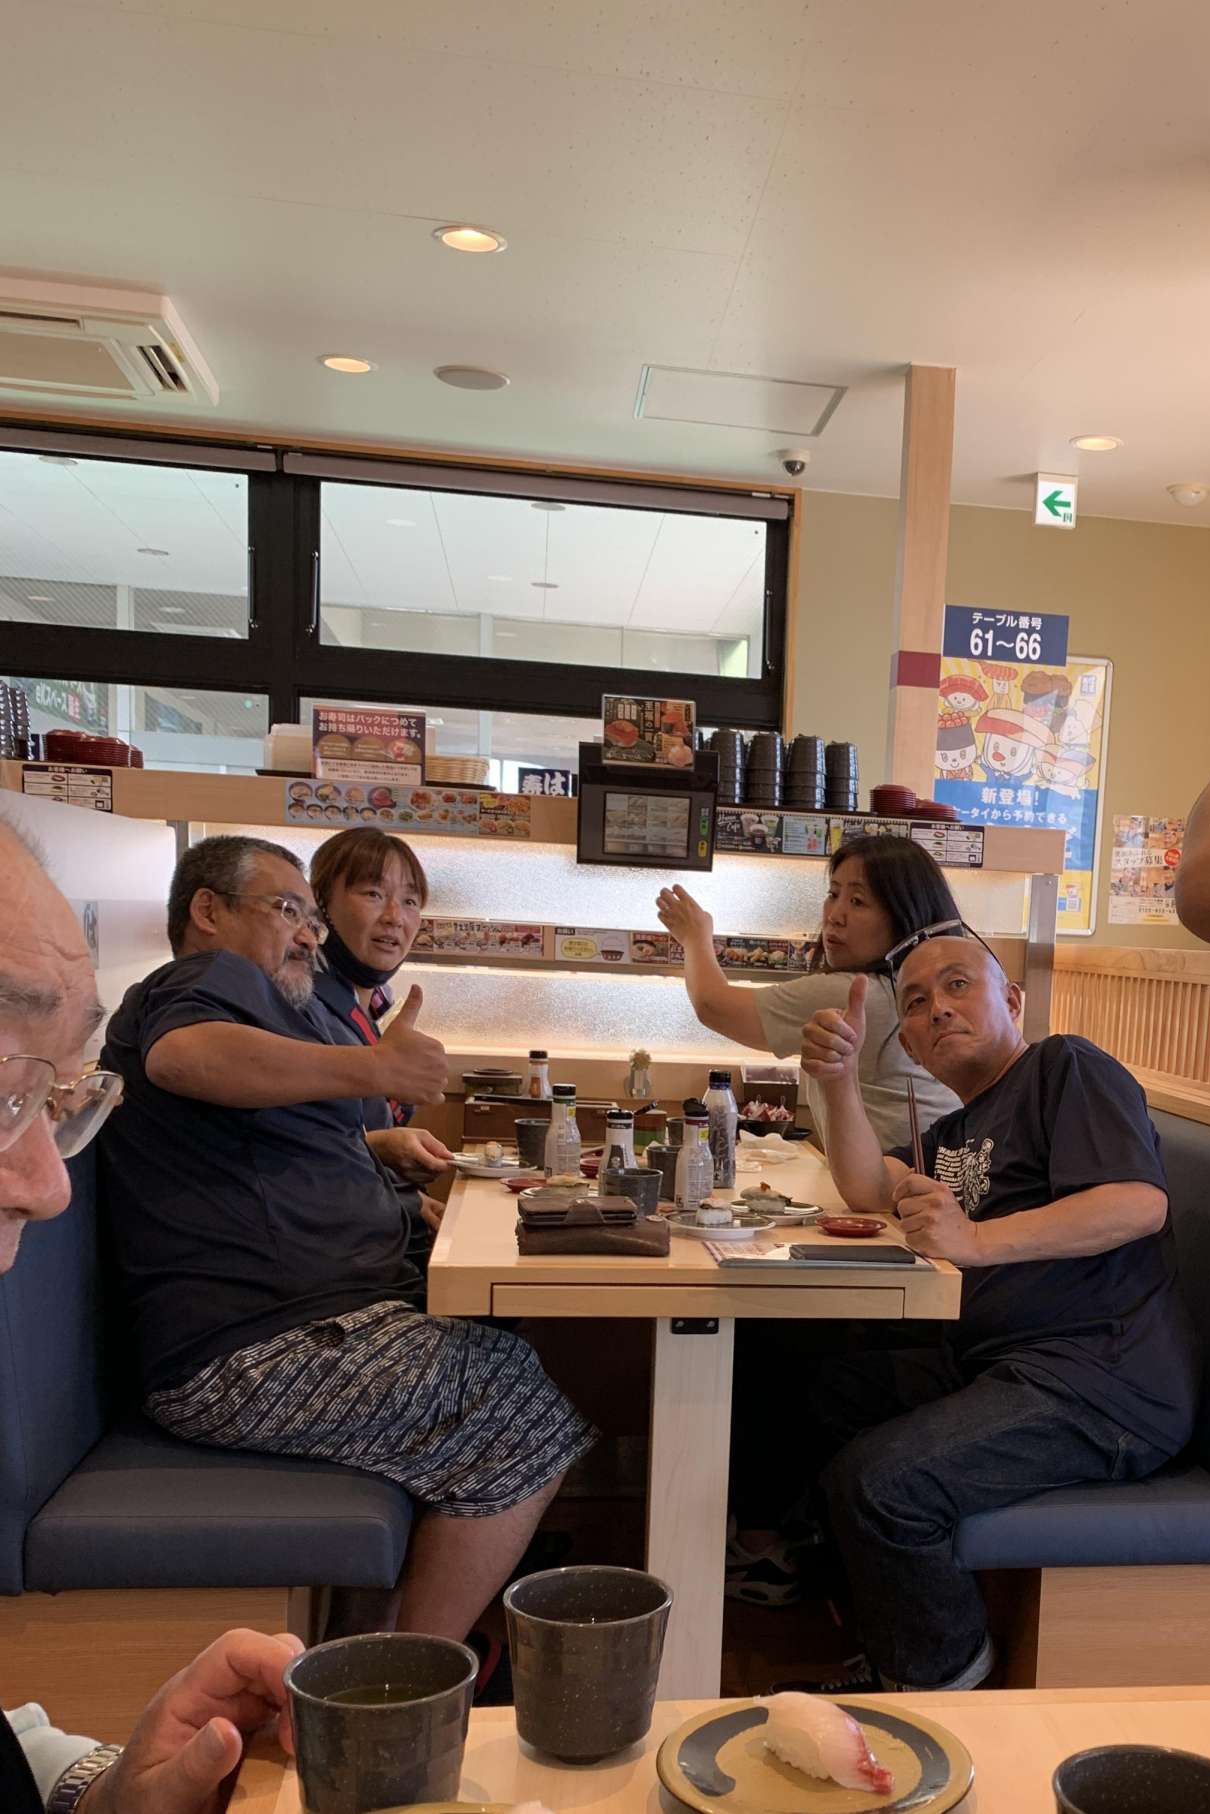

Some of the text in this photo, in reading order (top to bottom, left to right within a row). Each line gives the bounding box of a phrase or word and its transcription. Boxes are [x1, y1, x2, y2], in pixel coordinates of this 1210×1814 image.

[972, 613, 1042, 630] テーブル番号
[319, 712, 417, 727] お寿司はパックにつめて
[319, 722, 421, 739] お持ち帰りいただけます。
